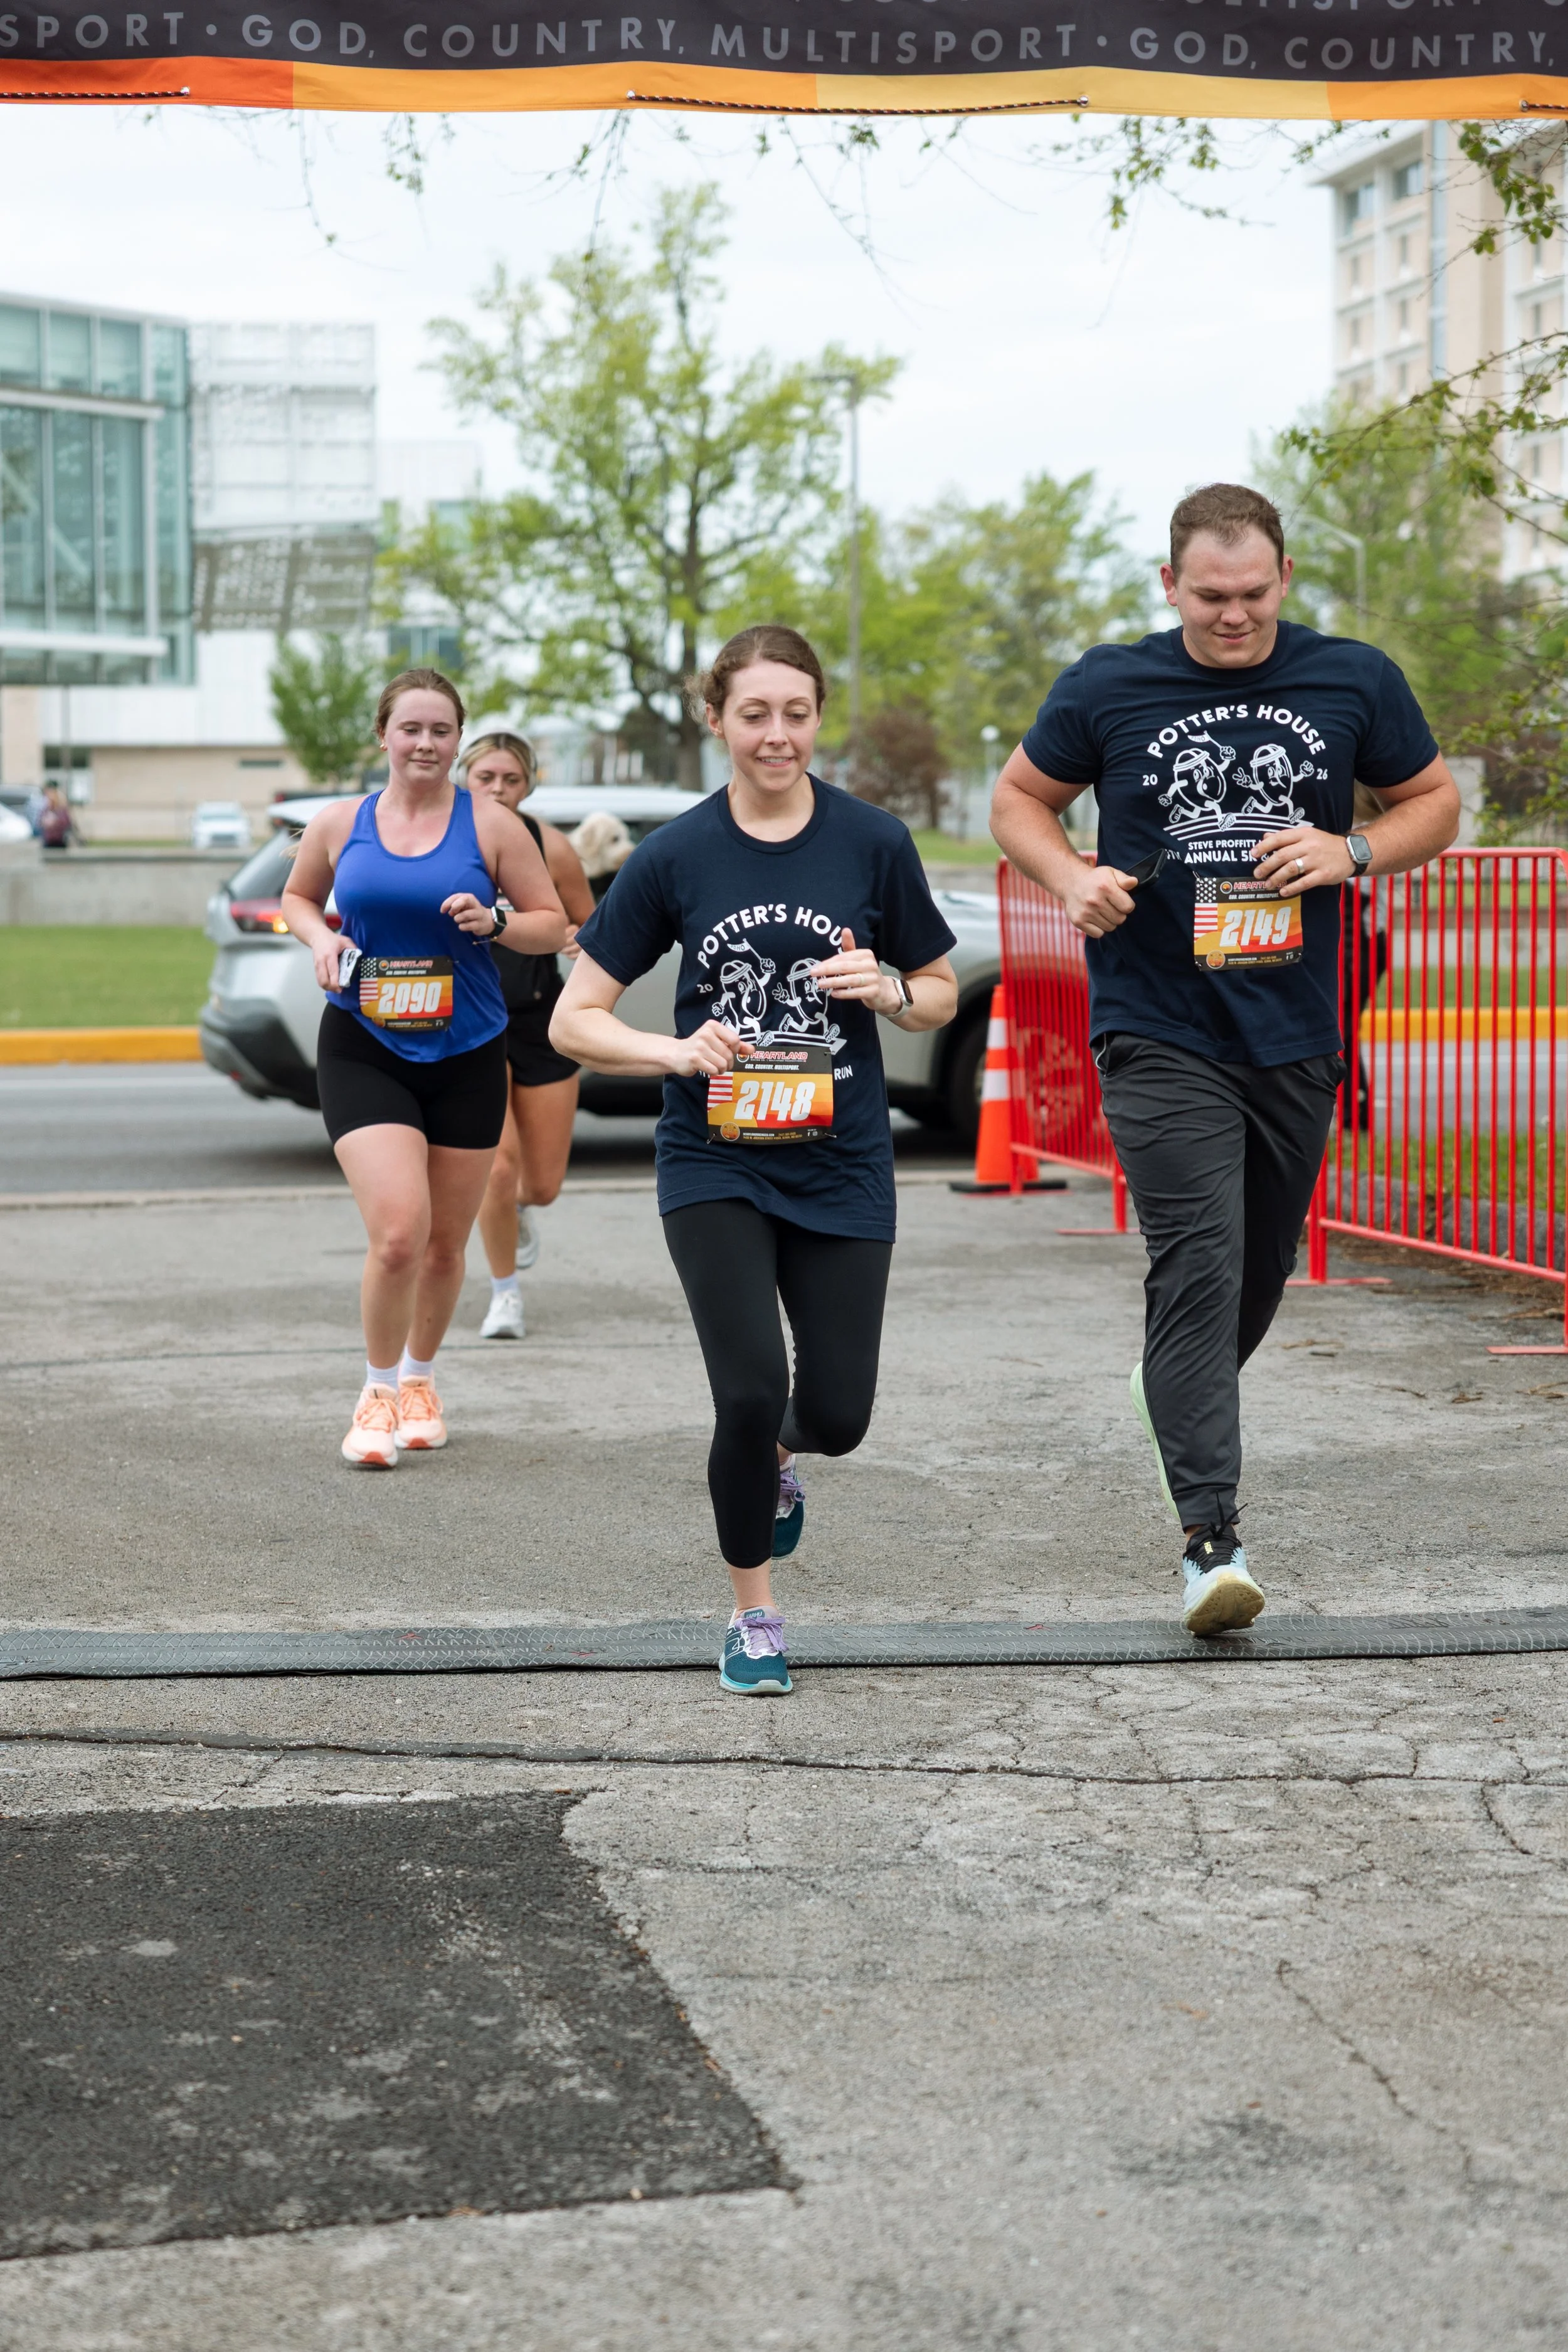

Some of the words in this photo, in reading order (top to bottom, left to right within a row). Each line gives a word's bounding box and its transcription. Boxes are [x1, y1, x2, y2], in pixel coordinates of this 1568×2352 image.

[241, 14, 374, 58] GOD,
[403, 17, 684, 58] COUNTRY,
[711, 24, 1077, 63] MULTISPORT
[1130, 27, 1257, 70] GOD,
[1284, 31, 1554, 70] COUNTRY,
[1147, 704, 1248, 758] POTTER'S
[1256, 704, 1327, 755] HOUSE
[1142, 773, 1158, 786] 20
[1316, 768, 1328, 780] 26
[1188, 840, 1214, 850] STEVE
[1216, 839, 1256, 848] PROFFITT
[1184, 850, 1238, 864] ANNUAL
[697, 904, 788, 969] POTTER'S
[794, 906, 845, 955] HOU
[1219, 906, 1292, 948] 2149
[377, 982, 443, 1014] 2090
[697, 983, 714, 993] 20
[750, 1051, 808, 1060] HEARTLAND
[834, 1065, 853, 1081] RUN
[733, 1080, 816, 1121] 2148
